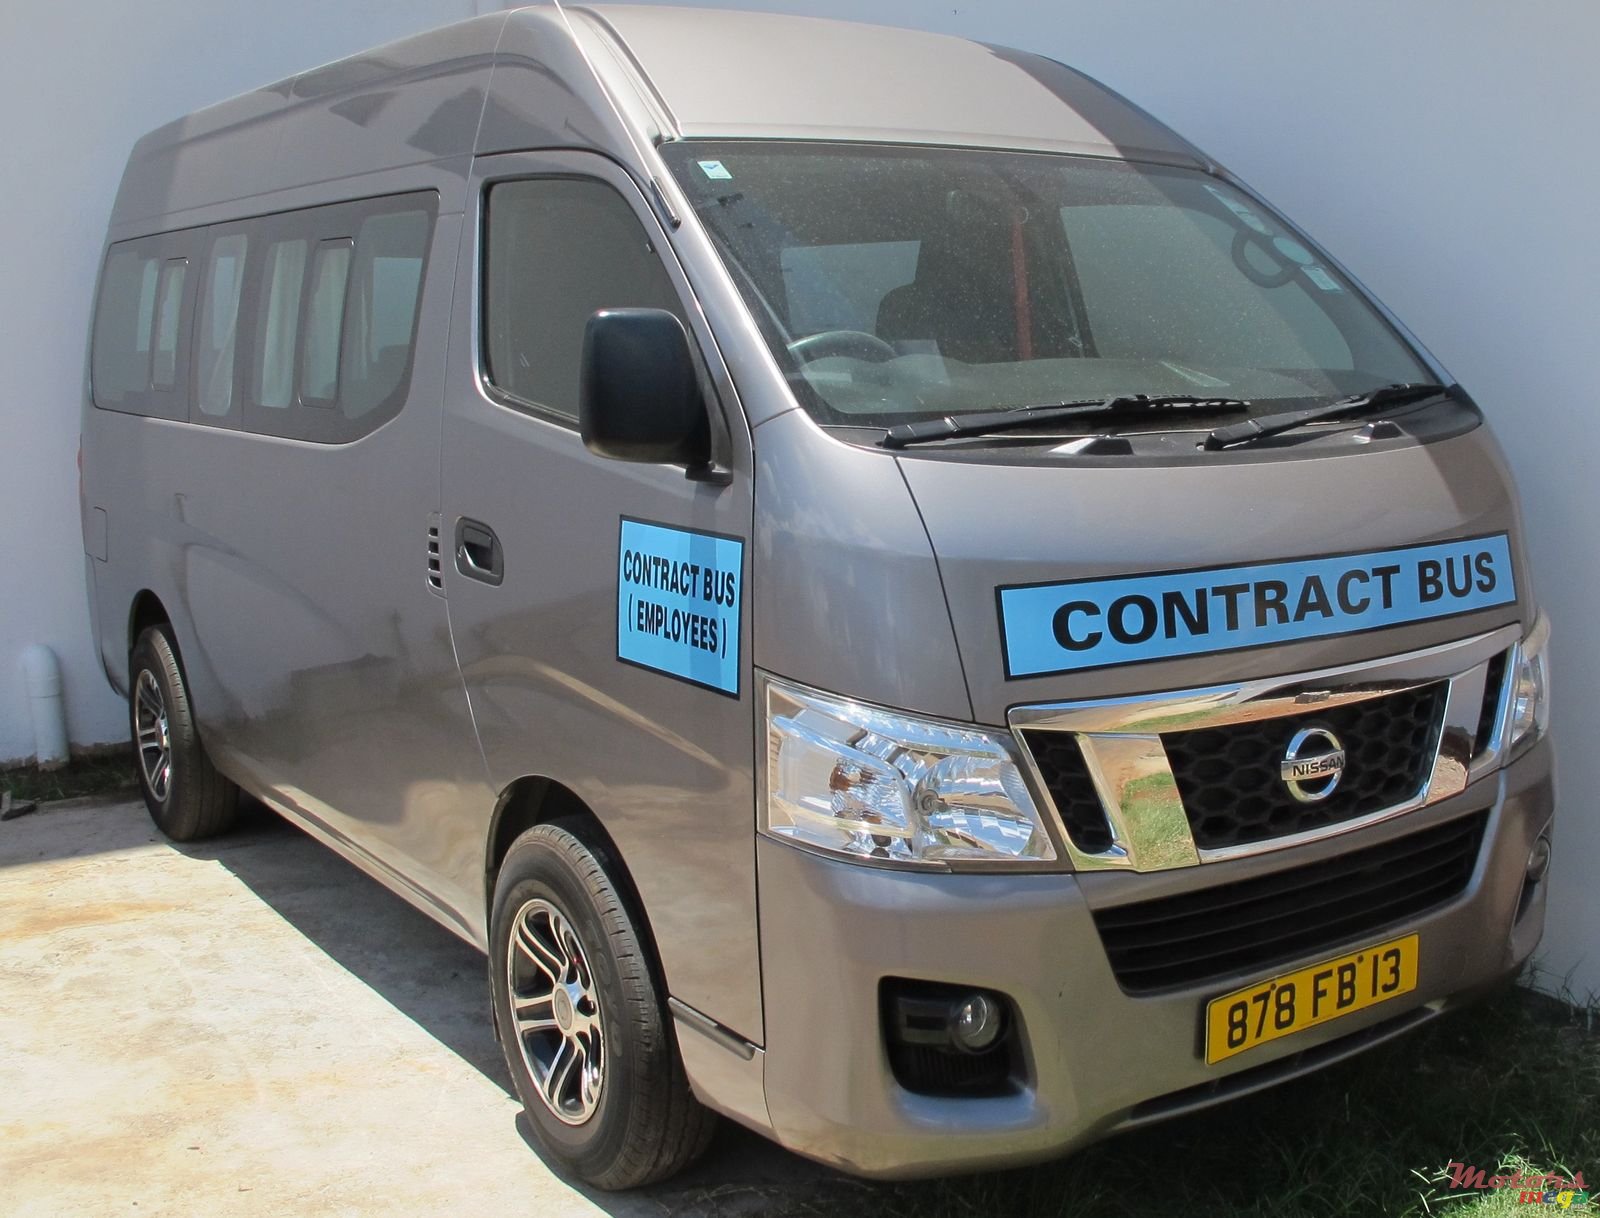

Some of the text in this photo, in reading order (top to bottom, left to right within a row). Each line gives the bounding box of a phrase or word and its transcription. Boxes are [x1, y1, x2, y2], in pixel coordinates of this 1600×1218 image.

[623, 549, 736, 608] CONTRACT BUS
[1052, 551, 1497, 652] CONTRACT BUS
[1292, 754, 1344, 777] NISSAN
[1227, 948, 1401, 1050] 878 FB 13
